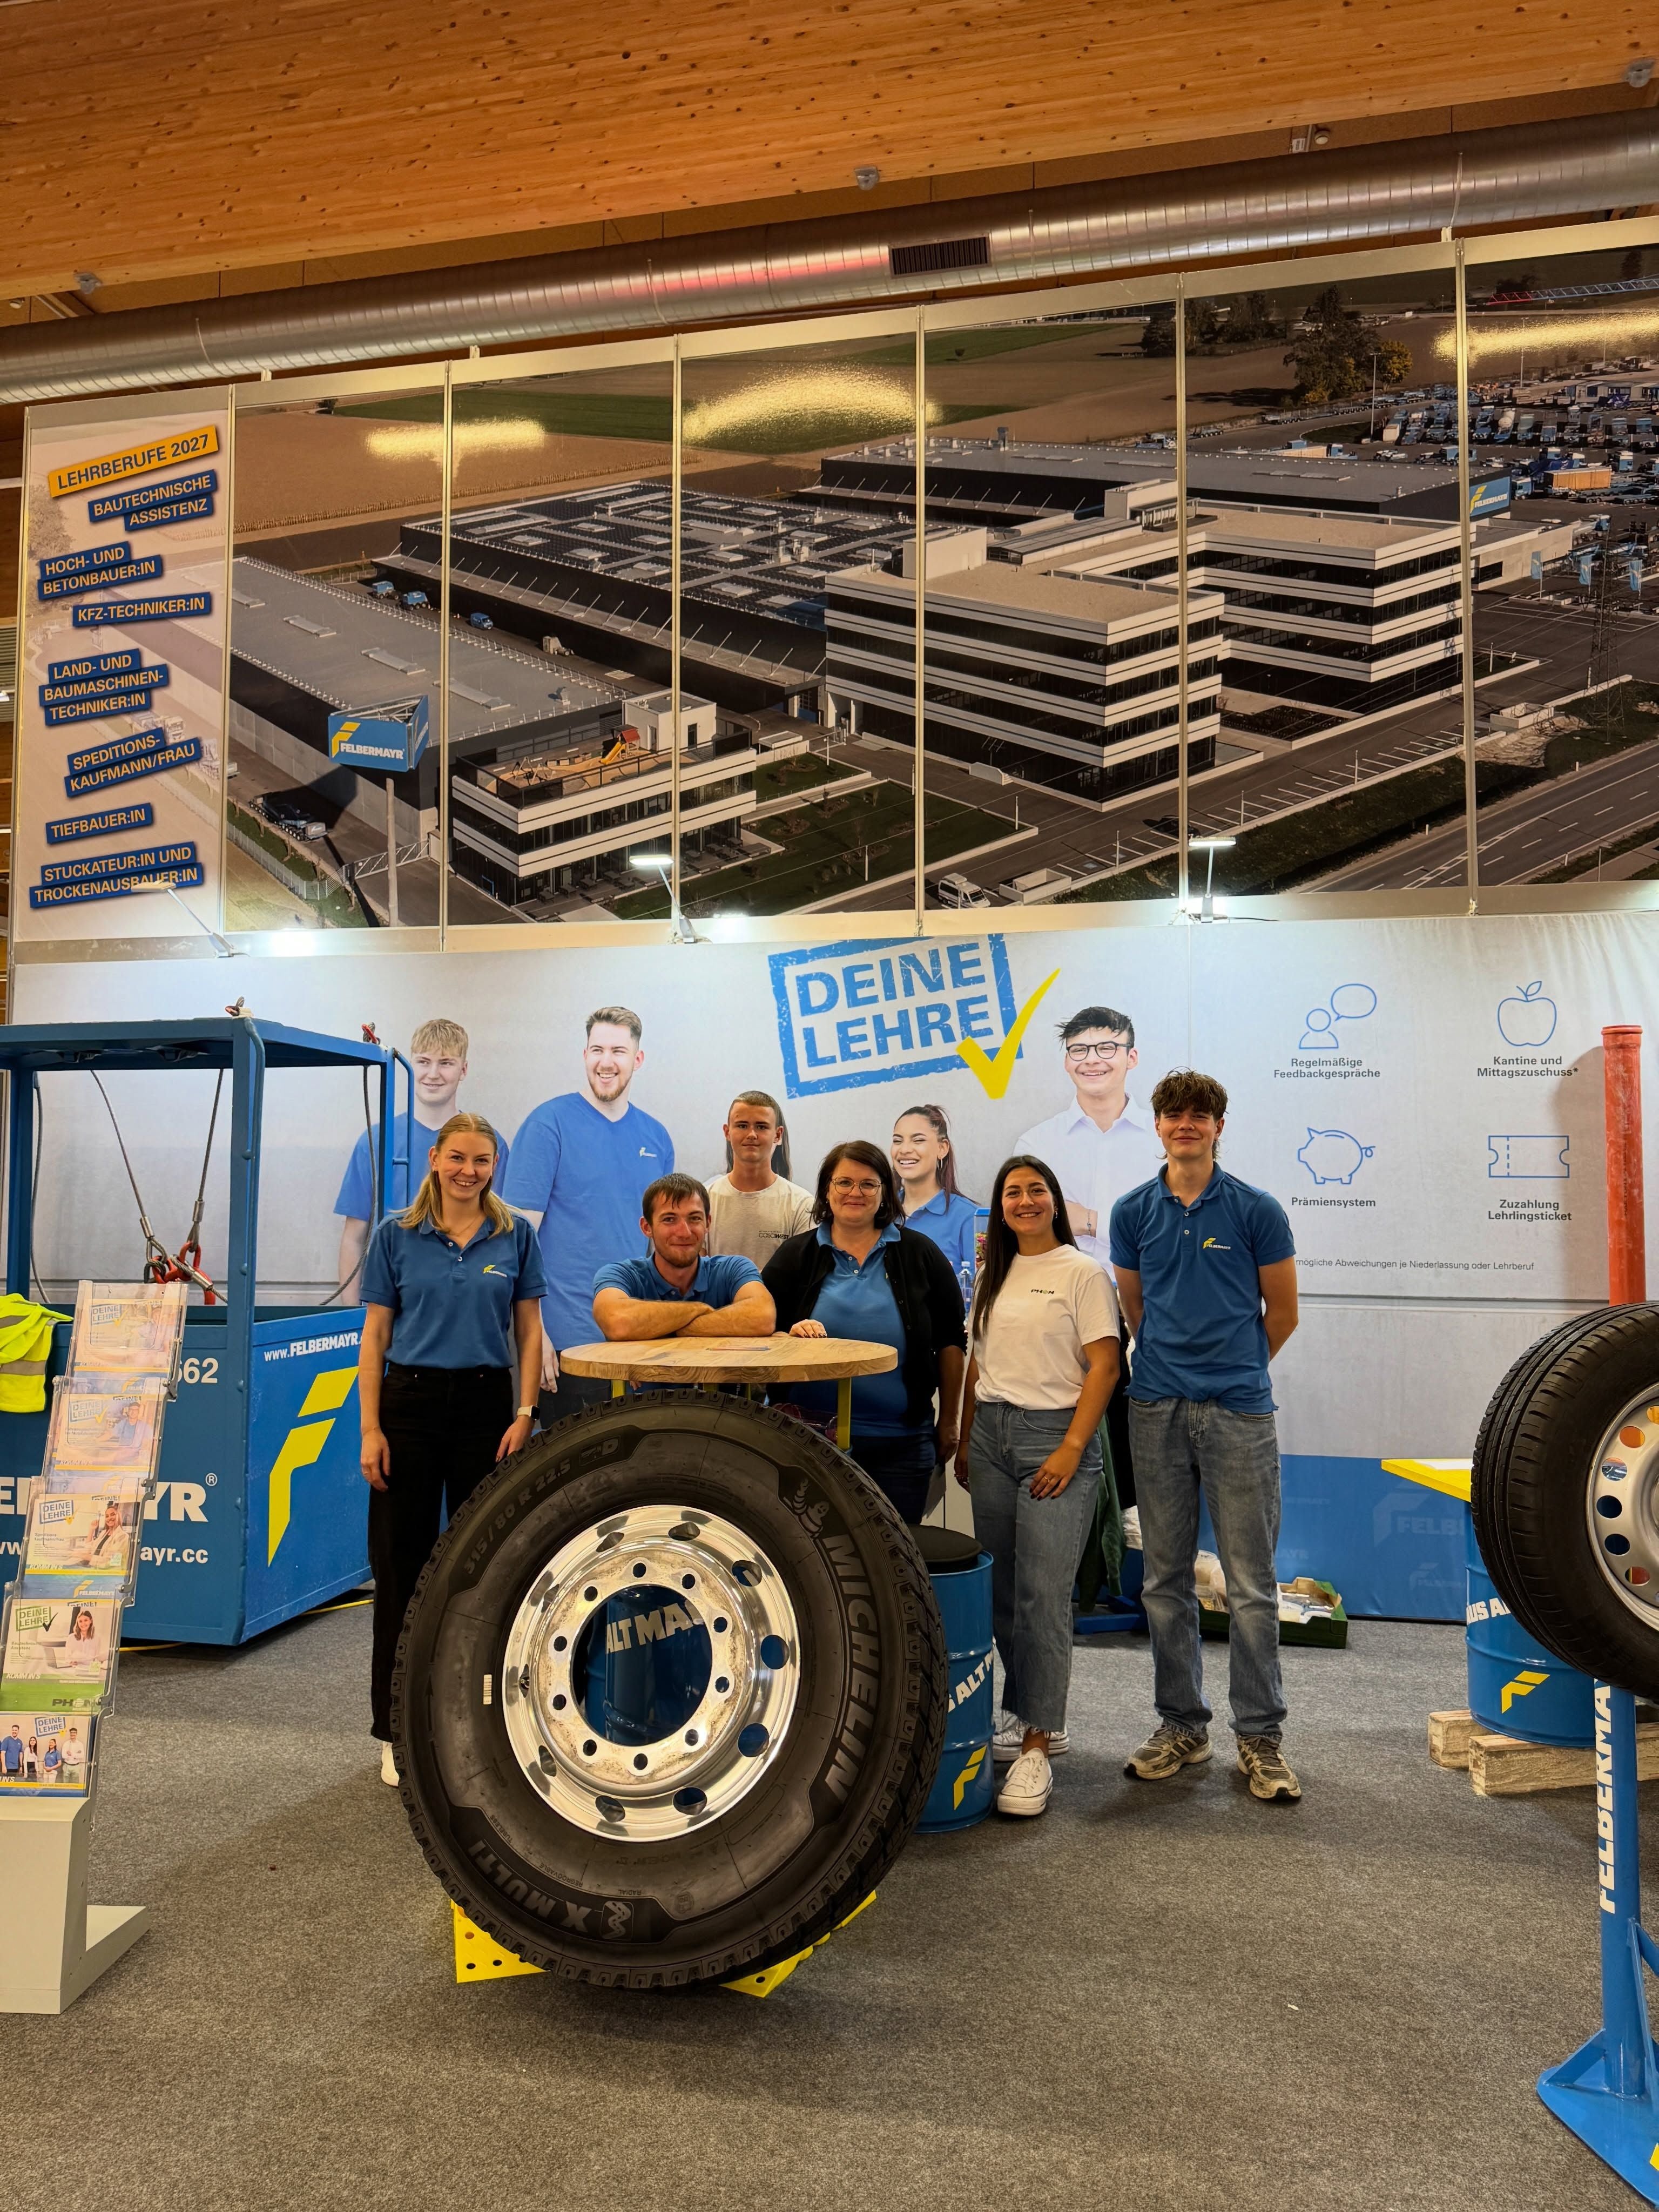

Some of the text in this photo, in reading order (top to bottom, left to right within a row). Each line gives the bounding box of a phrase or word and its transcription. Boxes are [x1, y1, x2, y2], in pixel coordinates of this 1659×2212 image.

[57, 434, 209, 489] LEHRBERUFE 2027
[94, 475, 211, 516] BAUTECHNISCHE
[129, 499, 207, 526] ASSISTENZ
[45, 547, 125, 576] HOCH- UND
[43, 561, 156, 595] BETONBAUER:IN
[78, 597, 205, 622] KFZ-TECHNIKER:IN
[53, 655, 132, 679] LAND- UND
[44, 670, 164, 701] BAUMASCHINEN-
[50, 692, 146, 720] TECHNIKER:IN
[72, 737, 160, 771] SPEDITIONS-
[340, 743, 403, 759] FELBERMAYR
[70, 743, 195, 791] KAUFMANN/FRAU
[51, 809, 145, 838] TIEFBAUER:IN
[44, 847, 191, 882] STUCKATEUR:IN UND
[795, 942, 986, 1017] DEINE
[802, 994, 994, 1068] LEHRE
[1291, 1058, 1363, 1068] Regelmäßige
[1493, 1056, 1562, 1065] Kantine und
[1274, 1069, 1381, 1080] Feedbackgespräche
[1291, 1197, 1376, 1208] Prämiensystem
[1499, 1199, 1560, 1210] Zuzahlung
[1488, 1211, 1572, 1222] Lehrlingsticket
[1296, 1259, 1534, 1270] mögliche Abweichungen je Niederlassung oder Lehrberuf
[518, 1487, 532, 1505] R
[535, 1459, 571, 1492] 22.5
[43, 1502, 71, 1512] DEINE
[43, 1510, 71, 1520] LEHRE
[19, 1608, 48, 1619] DEINE
[19, 1616, 49, 1627] LEHRE
[822, 1534, 880, 1805] MICHELIN
[38, 1717, 63, 1727] DEINE
[38, 1723, 64, 1734] LEHRE
[1594, 1678, 1615, 1914] FELBERMA
[489, 1815, 513, 1844] TUBELESS
[467, 1839, 593, 1933] X MULTI
[539, 1862, 583, 1888] REGROOVABLE
